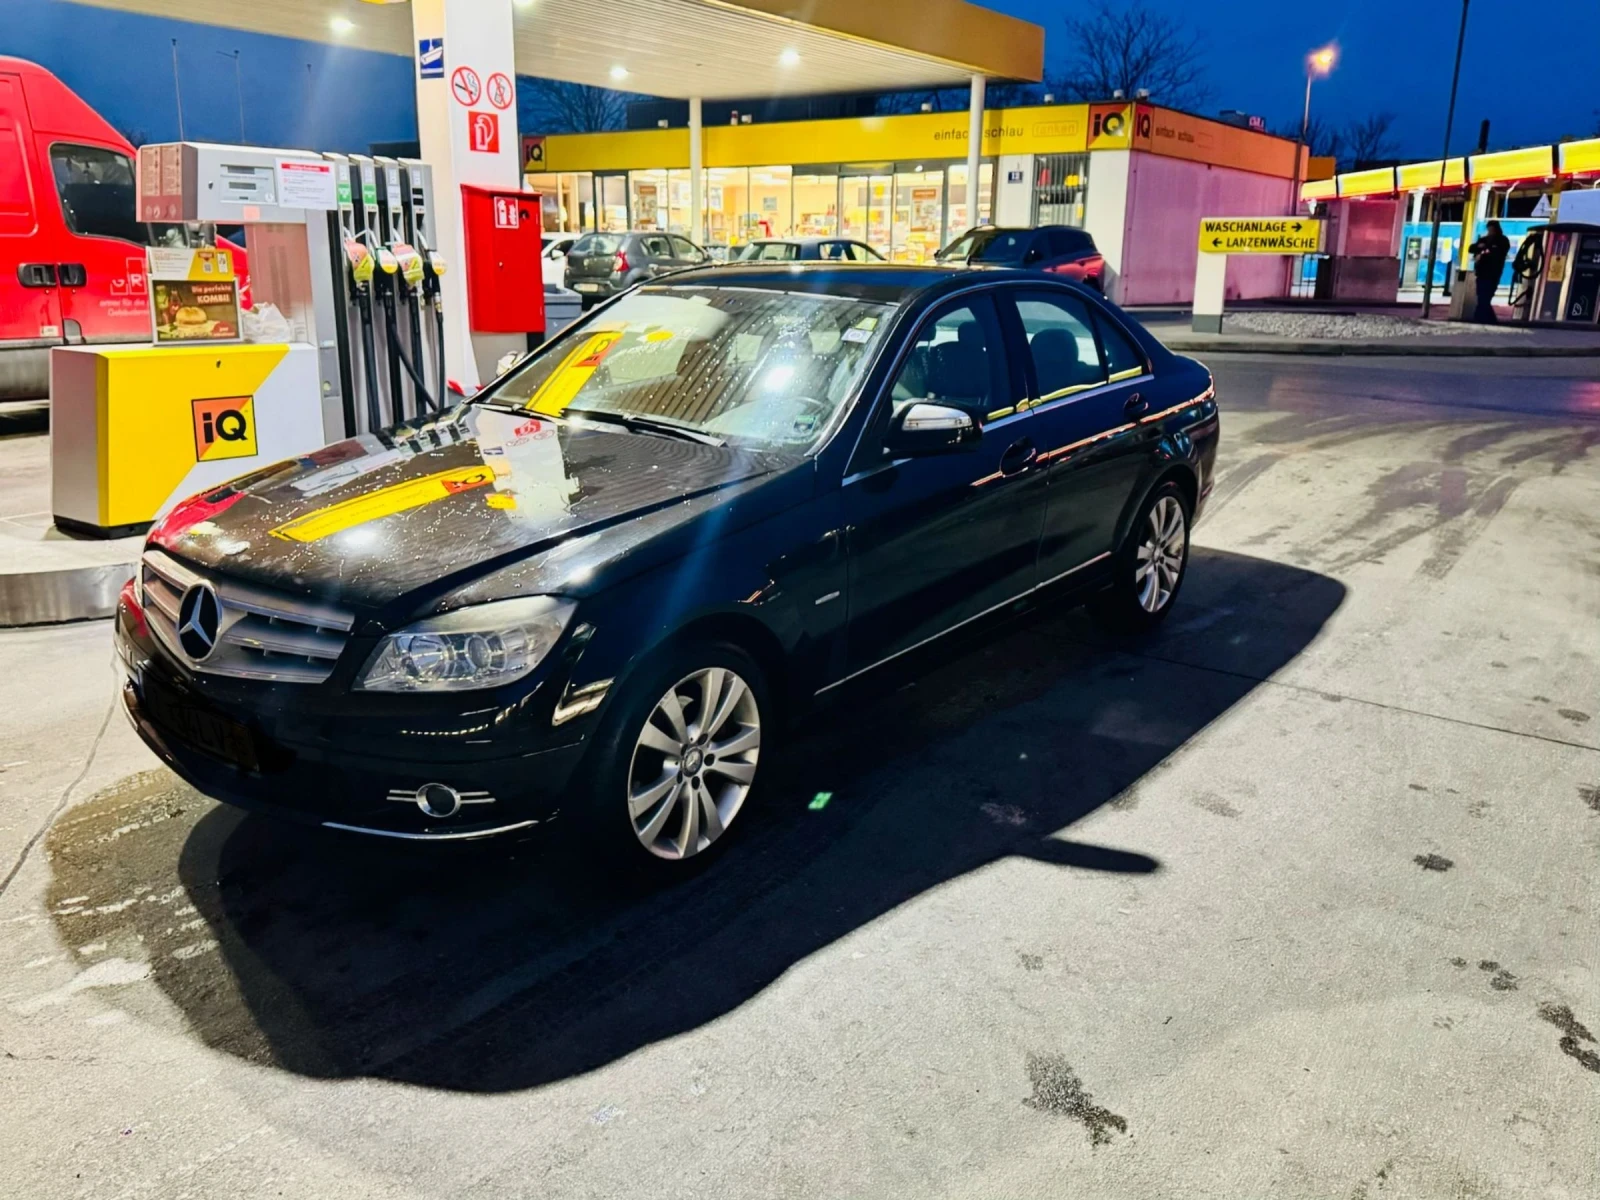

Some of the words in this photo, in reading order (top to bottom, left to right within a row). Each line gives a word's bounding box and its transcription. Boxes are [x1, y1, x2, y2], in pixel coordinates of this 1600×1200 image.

[1093, 111, 1125, 137] iQ
[934, 128, 968, 141] einfac
[984, 125, 1024, 138] schlau
[1205, 221, 1287, 233] WASCHANLAGE
[1226, 236, 1315, 248] LANZENWÄSCHE
[202, 409, 248, 443] iQ
